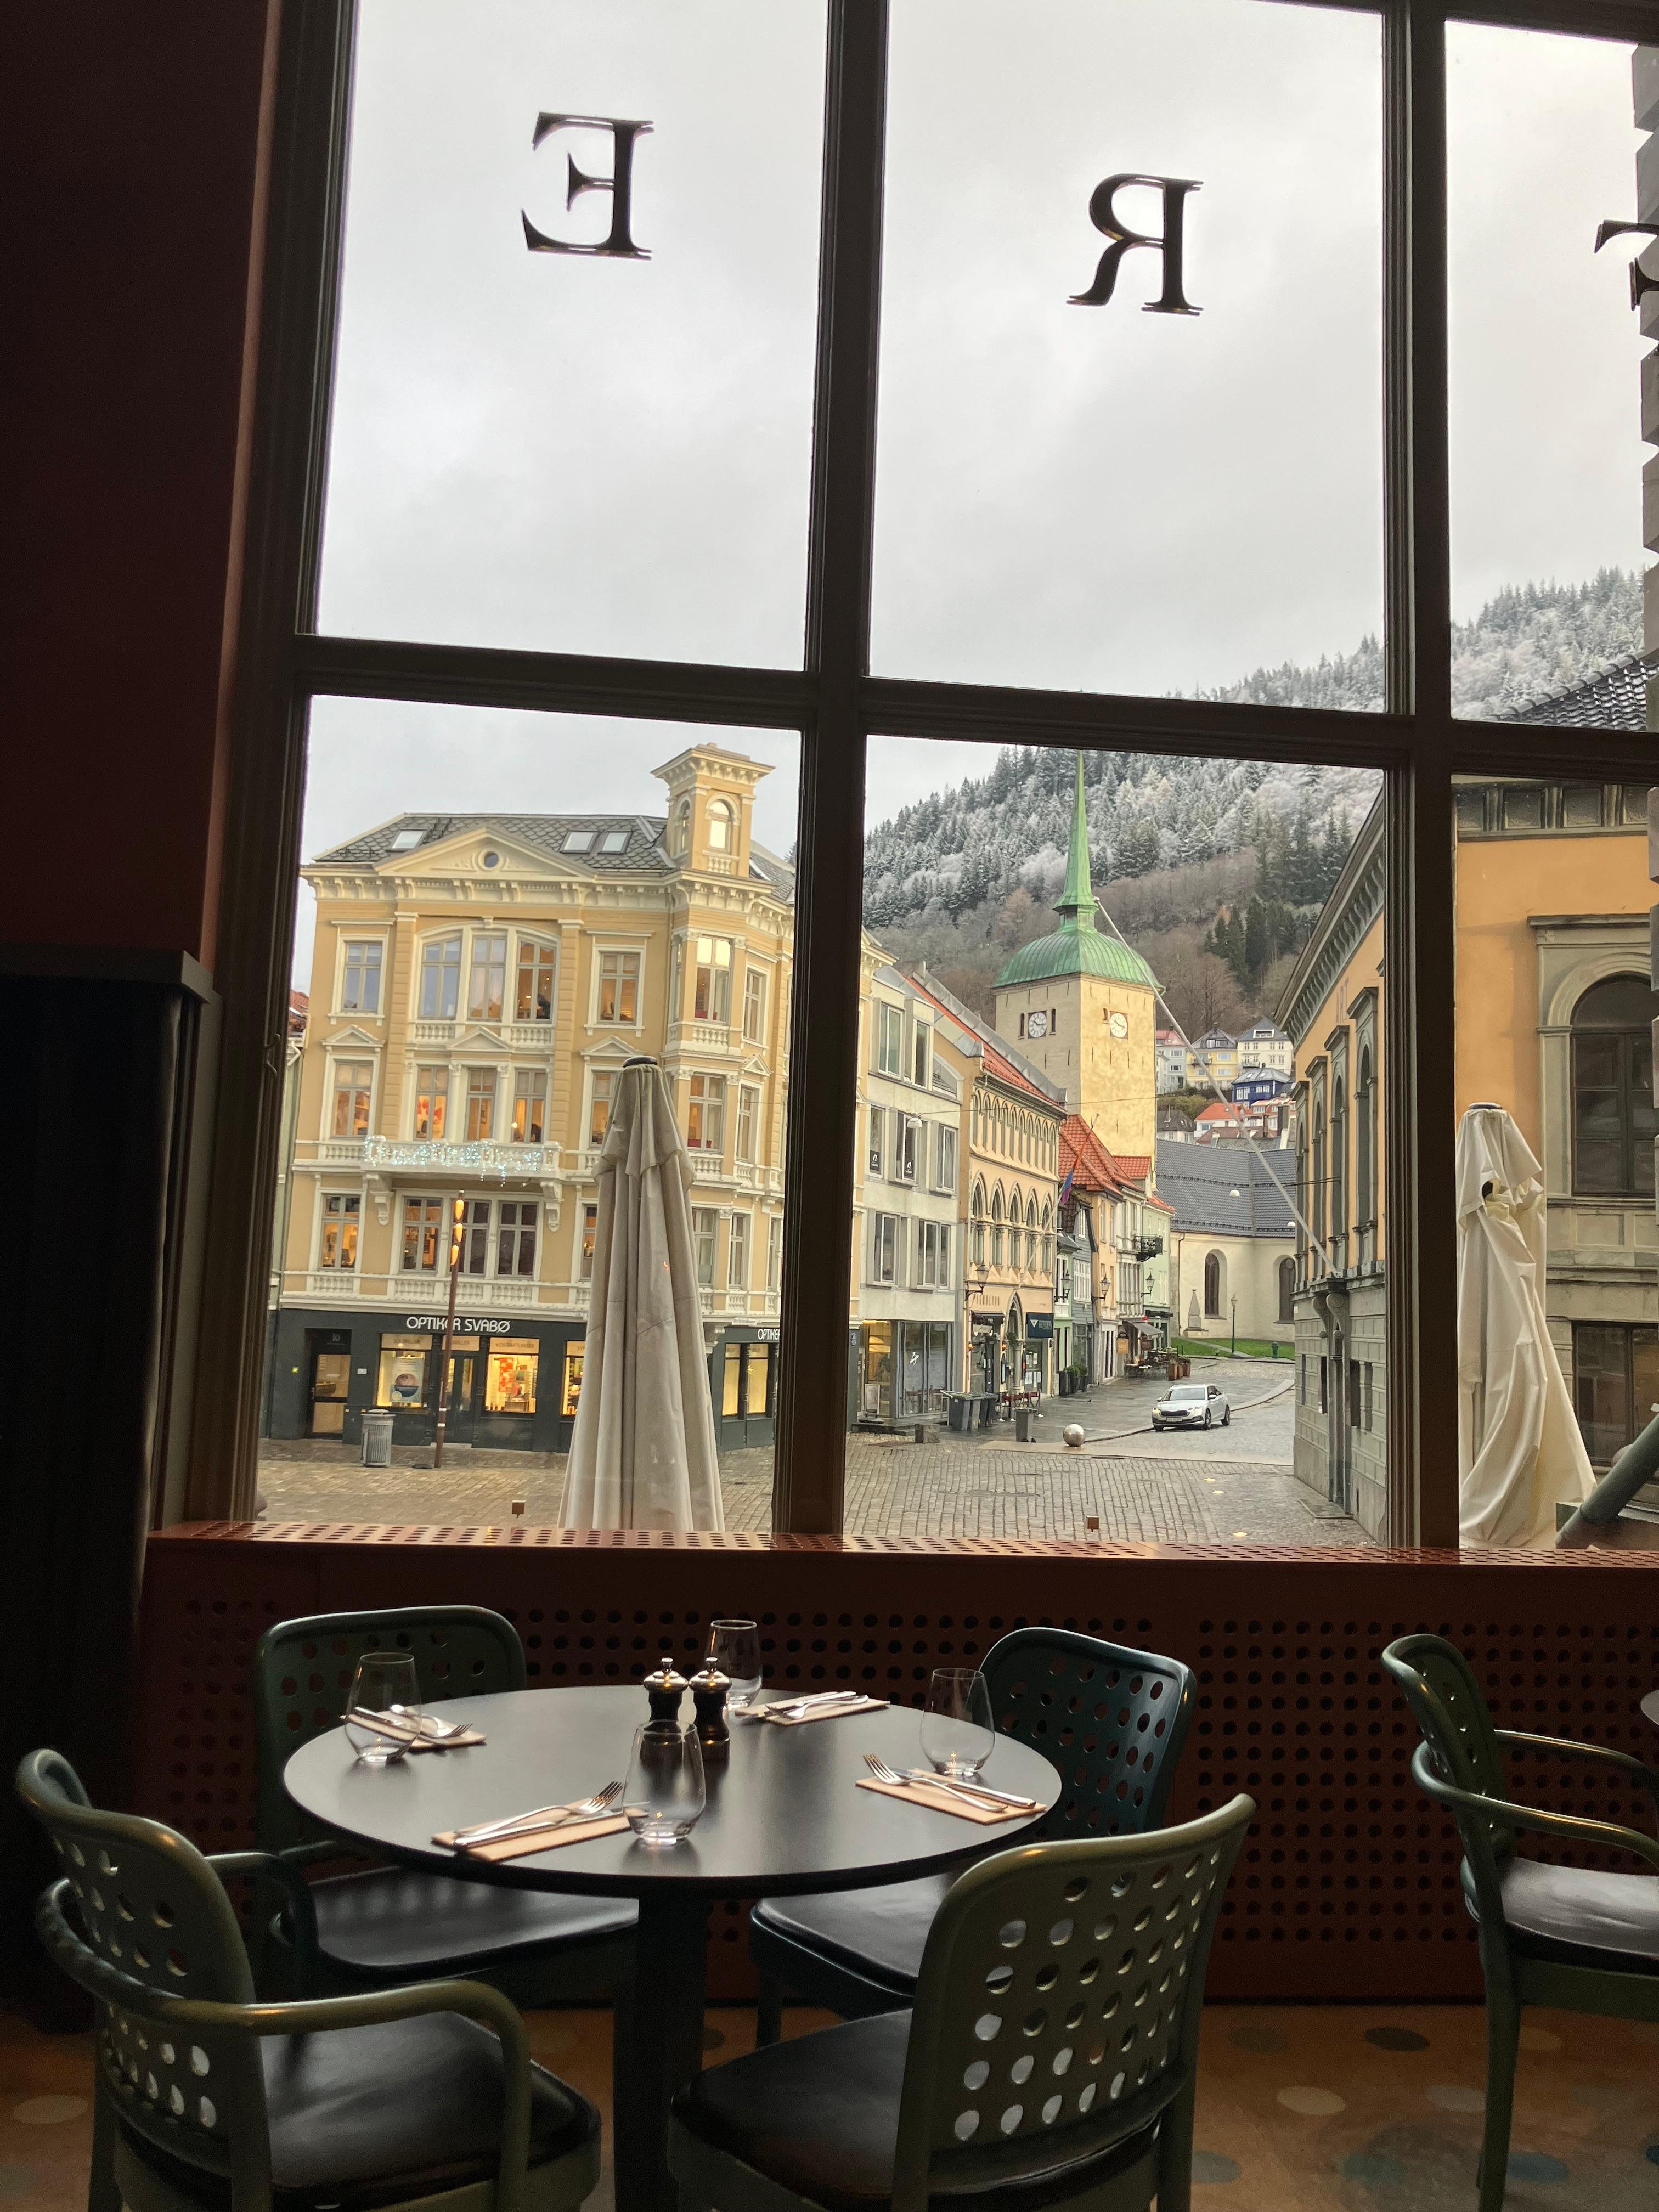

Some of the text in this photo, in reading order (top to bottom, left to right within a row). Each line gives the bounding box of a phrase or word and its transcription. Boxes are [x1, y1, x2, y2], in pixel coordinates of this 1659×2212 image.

[406, 1316, 510, 1333] OPTIKR SVABØ
[758, 1328, 780, 1340] OPTIKE
